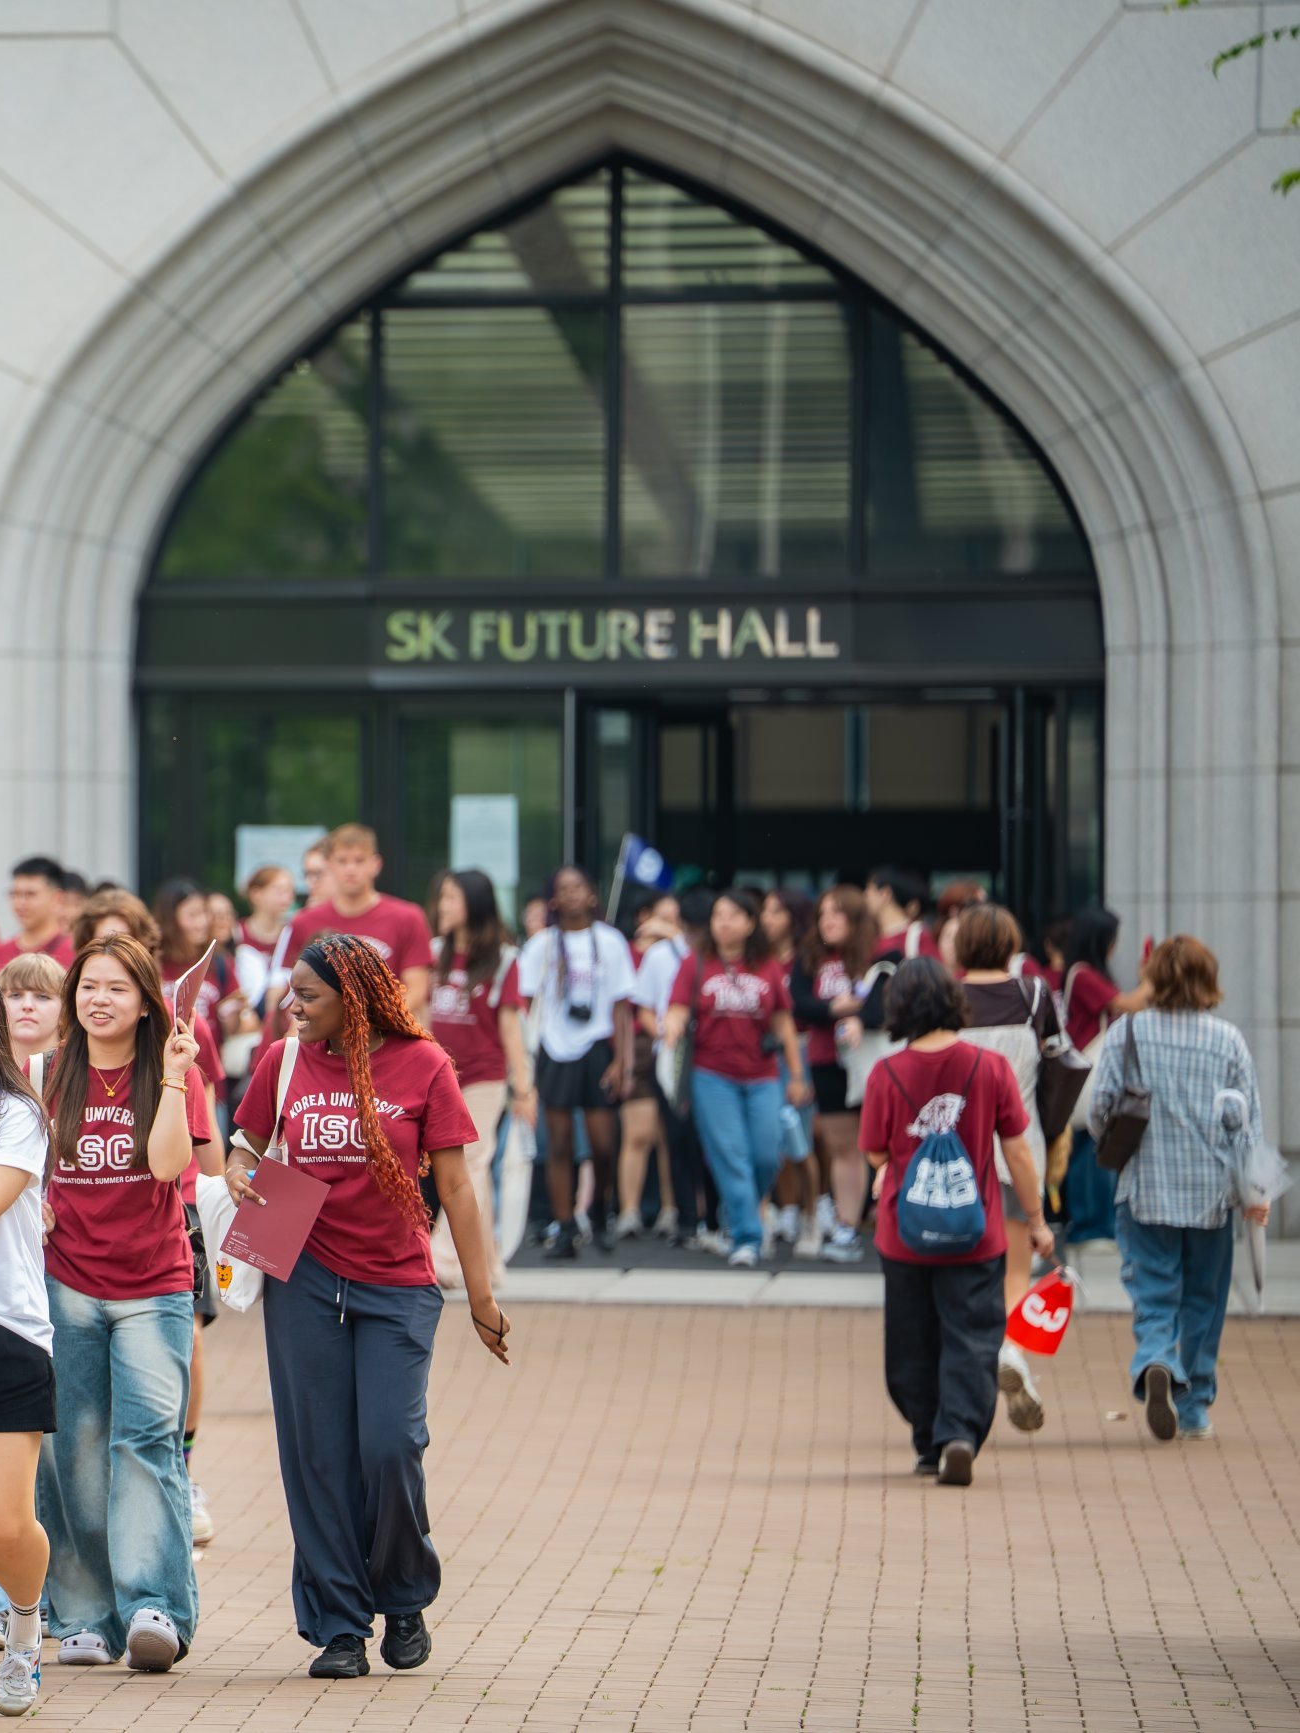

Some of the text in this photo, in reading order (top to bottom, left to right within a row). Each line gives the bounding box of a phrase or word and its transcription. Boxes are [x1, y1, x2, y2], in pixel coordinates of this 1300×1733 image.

[385, 607, 839, 662] SK FUTURE HALL
[85, 1106, 135, 1126] UNIVERS
[289, 1093, 406, 1120] KOREA UNIRSITY
[294, 1155, 336, 1164] TERNATIONAL
[52, 1173, 152, 1185] TERNATIONAL SUMMER CAMPUS
